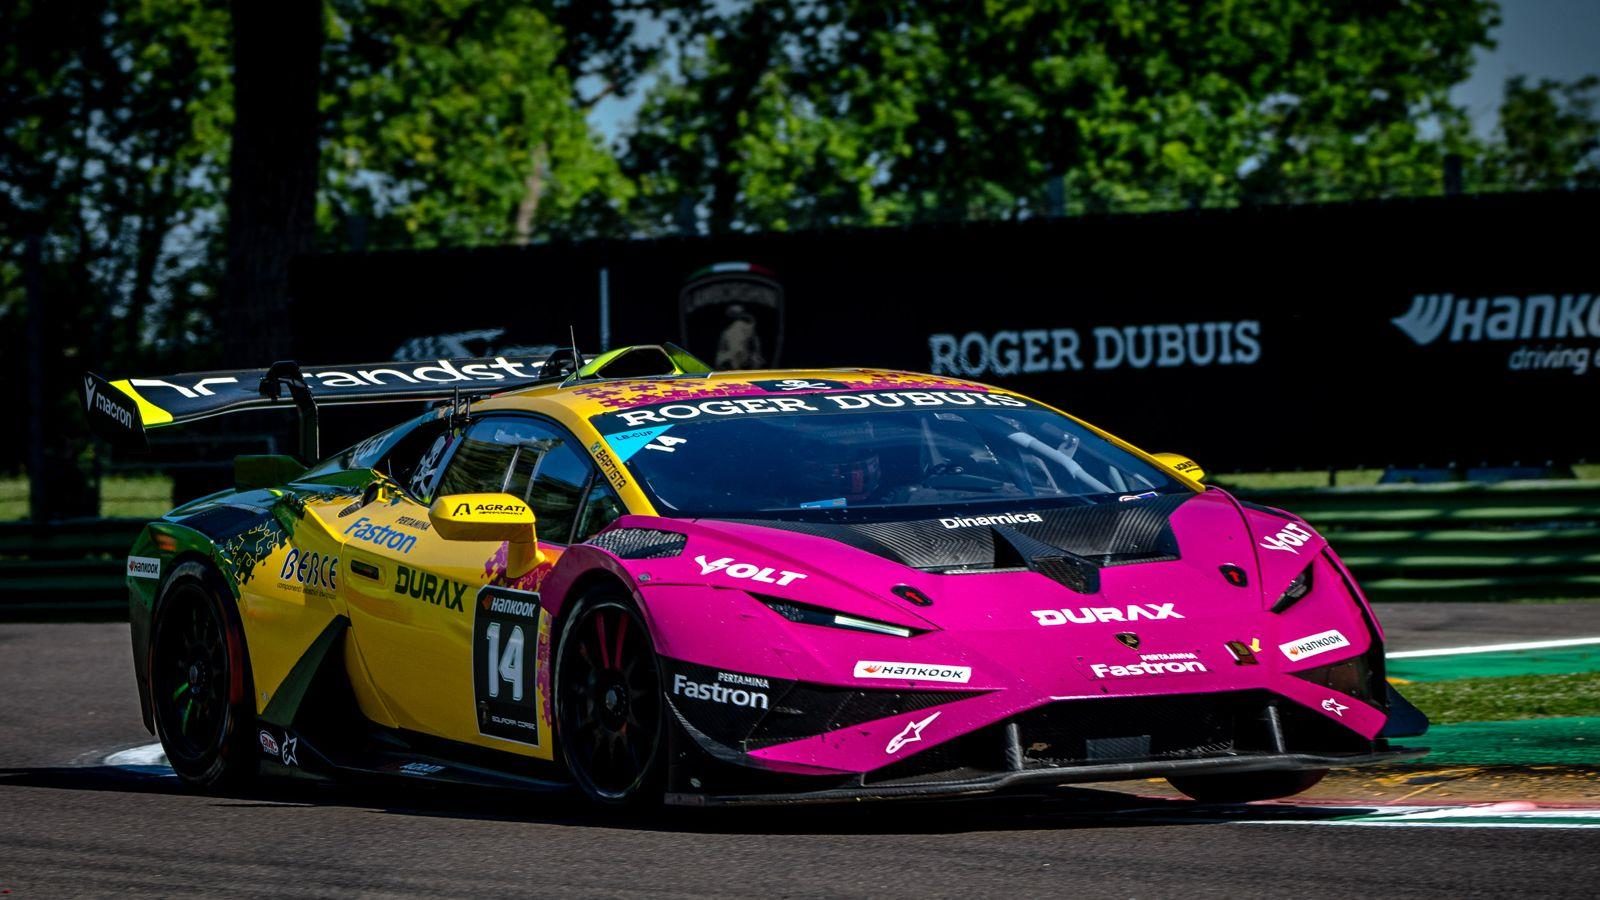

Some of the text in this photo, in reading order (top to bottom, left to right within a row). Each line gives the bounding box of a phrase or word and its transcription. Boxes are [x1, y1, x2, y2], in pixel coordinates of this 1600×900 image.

[929, 321, 1262, 377] ROGER DUBUIS
[1508, 345, 1590, 375] driving
[96, 391, 132, 429] macron
[616, 391, 1028, 427] ROGER DUBUIS
[645, 435, 688, 453] 14
[595, 448, 628, 491] BAPTISTA
[474, 503, 527, 513] AGRATI
[939, 511, 1043, 531] Dinamica
[344, 516, 418, 555] Fastron
[1260, 522, 1313, 555] VOLT
[280, 548, 338, 591] BERCE
[694, 554, 808, 586] VOLT
[395, 565, 468, 613] DURAX
[1030, 602, 1185, 627] DURAX
[486, 621, 525, 702] 14
[1090, 659, 1208, 679] Fastron
[672, 673, 769, 710] Fastron
[717, 671, 770, 689] PERTAMINA
